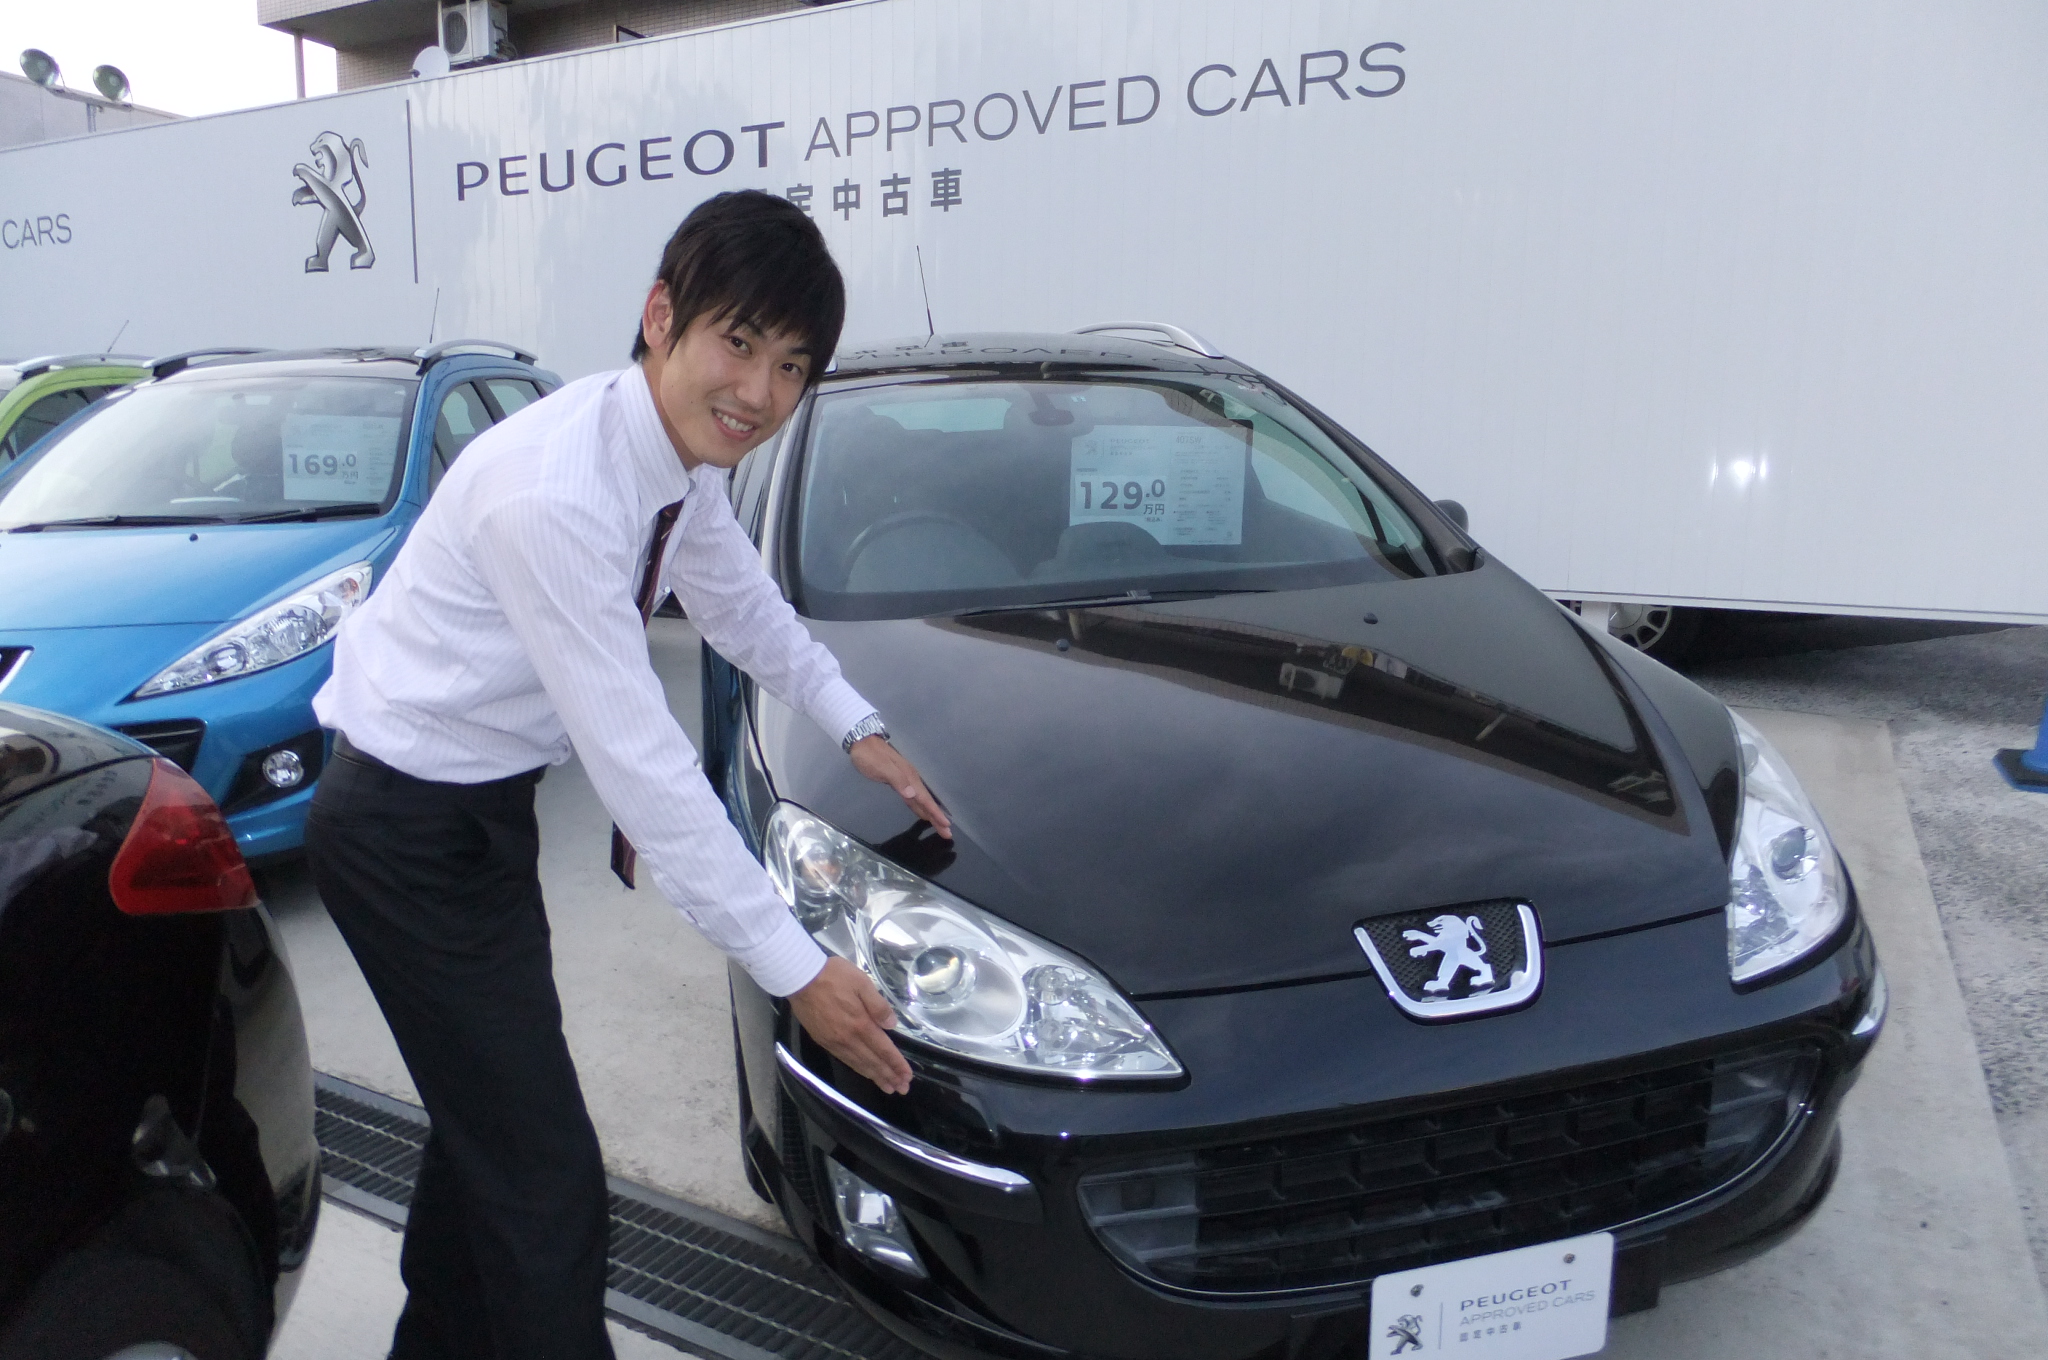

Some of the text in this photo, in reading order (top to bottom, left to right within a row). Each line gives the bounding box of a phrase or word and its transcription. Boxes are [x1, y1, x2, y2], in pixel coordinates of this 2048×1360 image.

[456, 42, 1406, 202] PEUGEOT APPROVED CARS
[752, 167, 963, 221] 定中古車
[2, 213, 72, 249] CARS
[1143, 503, 1165, 515] 万円
[1460, 1279, 1572, 1311] PEUGEOT
[1460, 1290, 1596, 1326] APPROVED CARS
